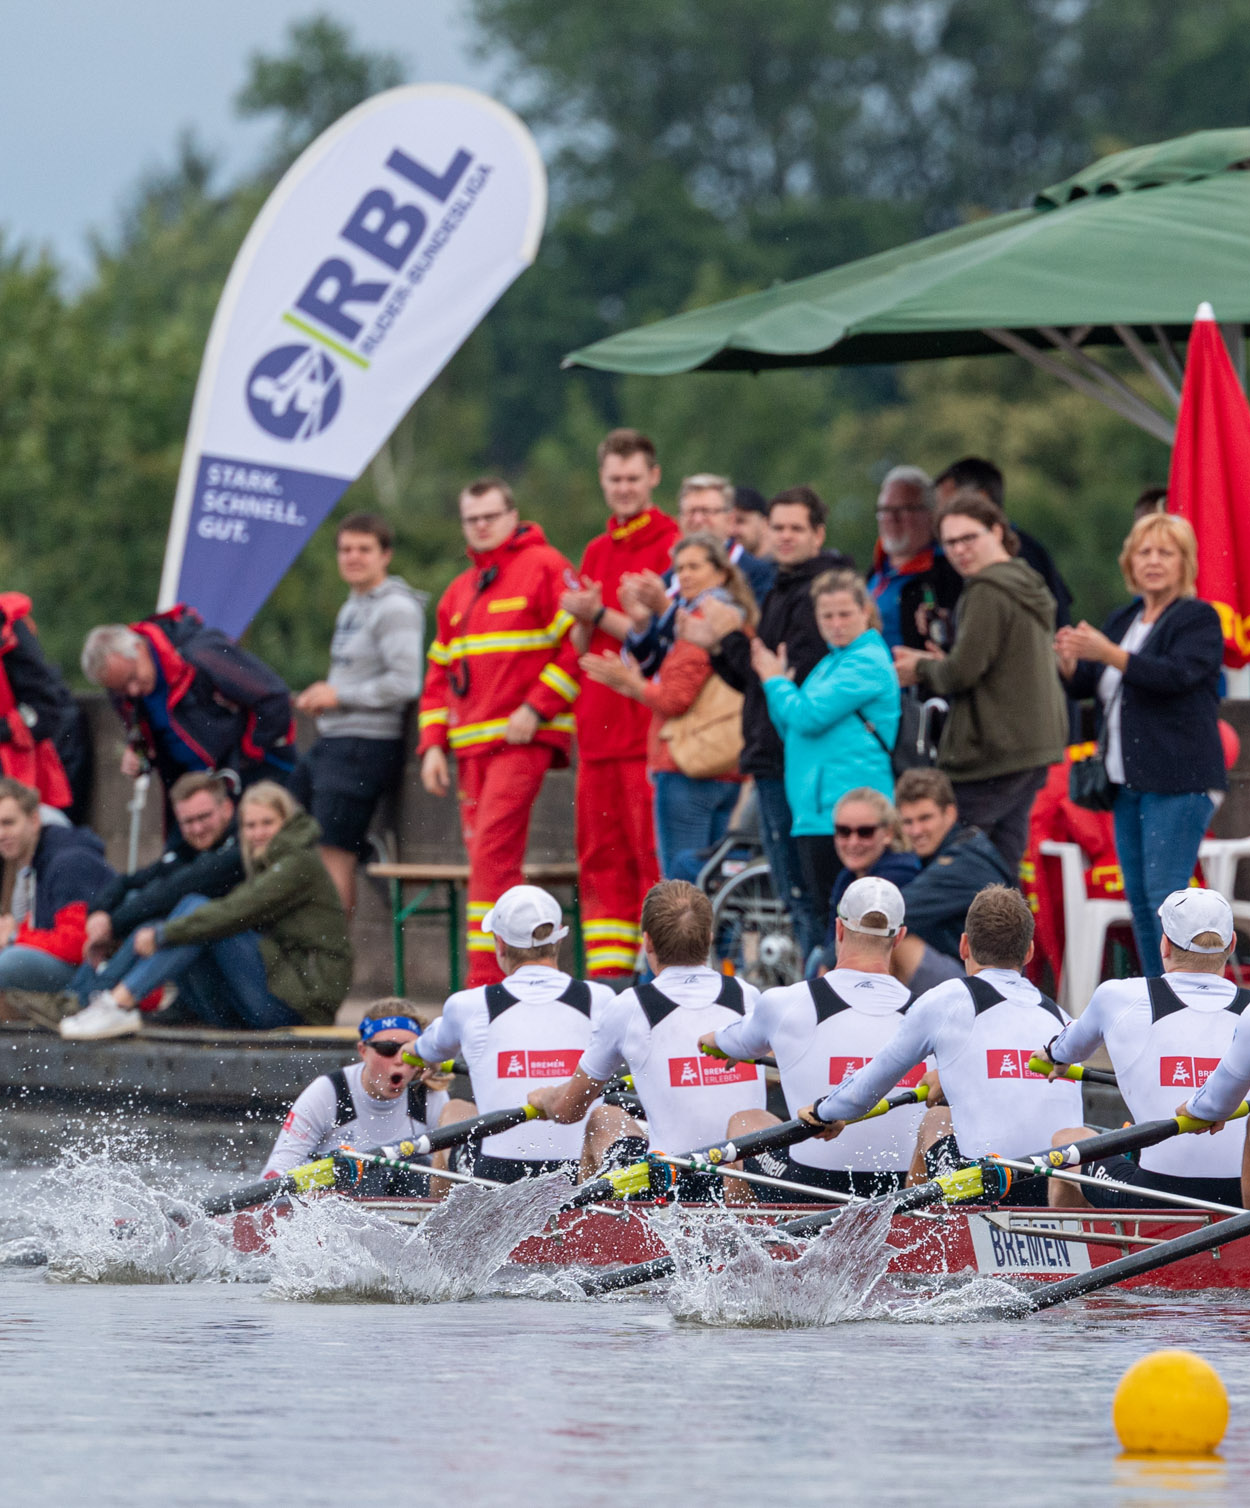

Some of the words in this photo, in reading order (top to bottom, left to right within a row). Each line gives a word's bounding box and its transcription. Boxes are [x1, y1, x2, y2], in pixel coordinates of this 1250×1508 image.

[295, 147, 473, 342] RBL
[361, 166, 493, 357] RUDER-BUNDESLIGA
[206, 463, 284, 496] STARK.
[202, 489, 307, 526] SCHNELL.
[198, 515, 249, 544] GUT.
[530, 1061, 565, 1069] BREMEN
[704, 1074, 741, 1083] ERLEBEN!
[989, 1224, 1071, 1268] BREMEN
